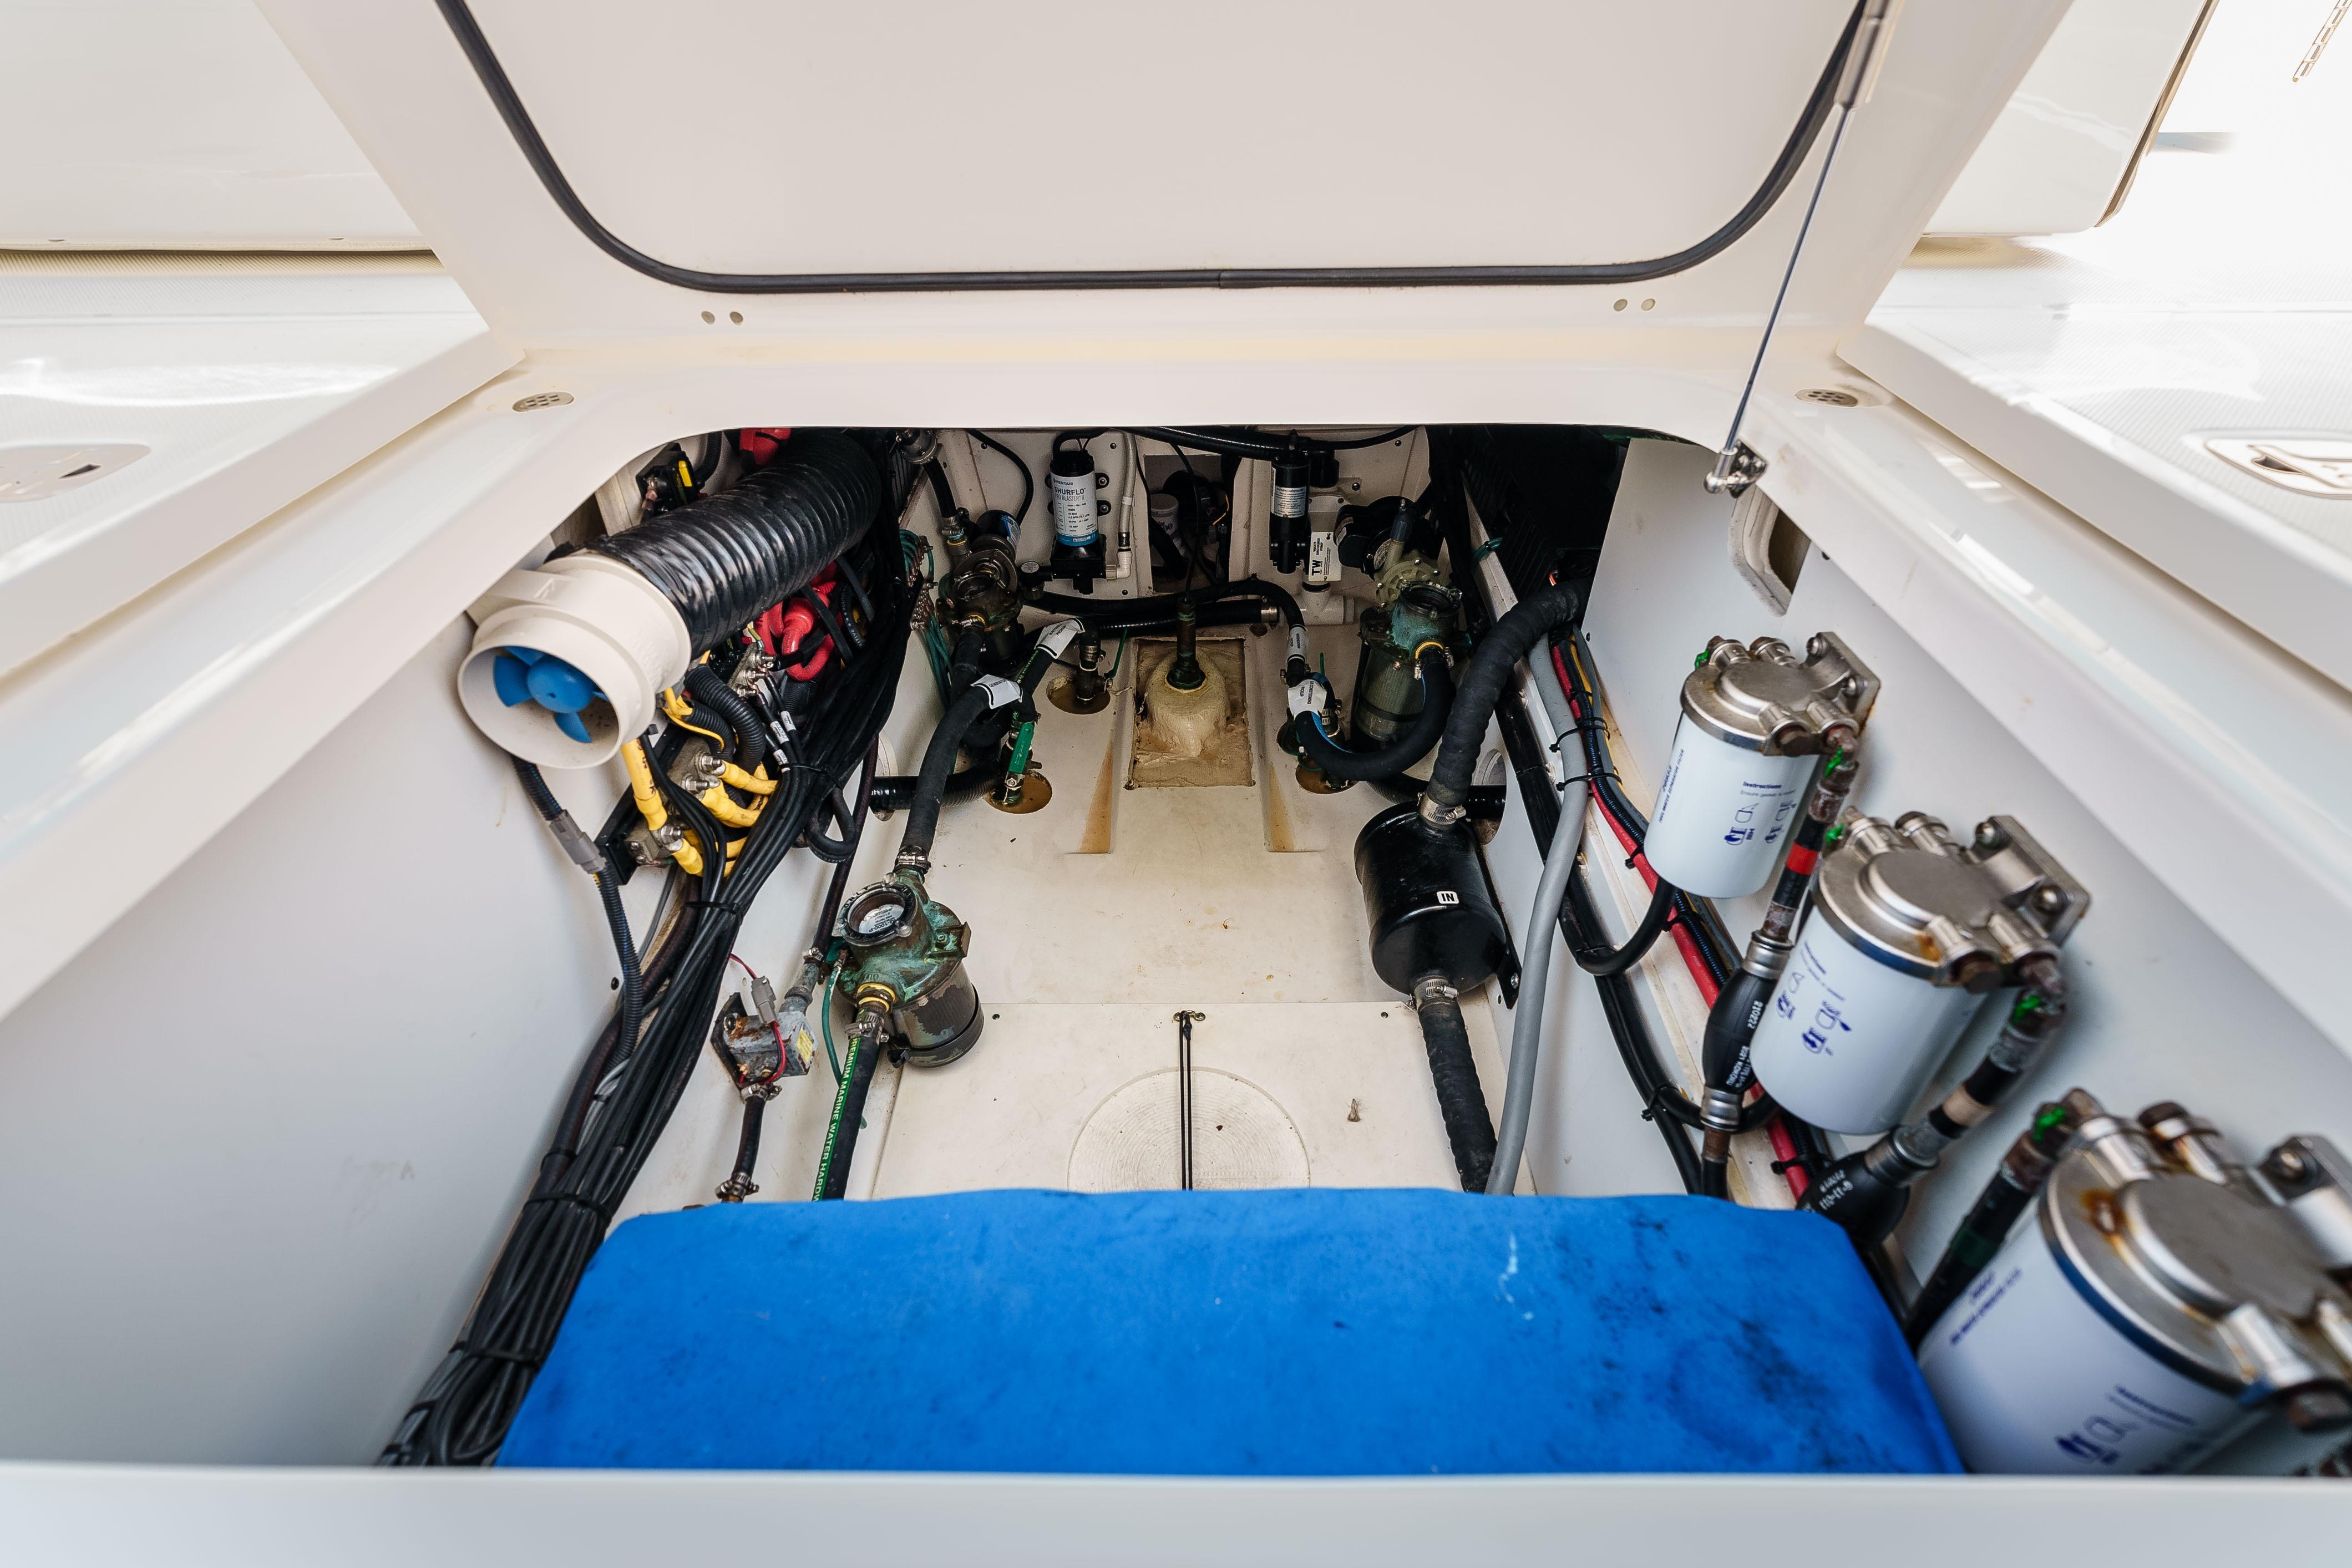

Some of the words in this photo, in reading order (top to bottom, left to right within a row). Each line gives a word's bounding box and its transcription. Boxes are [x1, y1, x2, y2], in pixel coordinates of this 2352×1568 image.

[1054, 487, 1084, 495] SHURFLO
[1311, 560, 1321, 576] TW
[1441, 893, 1456, 902] IN
[833, 1081, 848, 1120] MARINE
[822, 1123, 837, 1160] WATER
